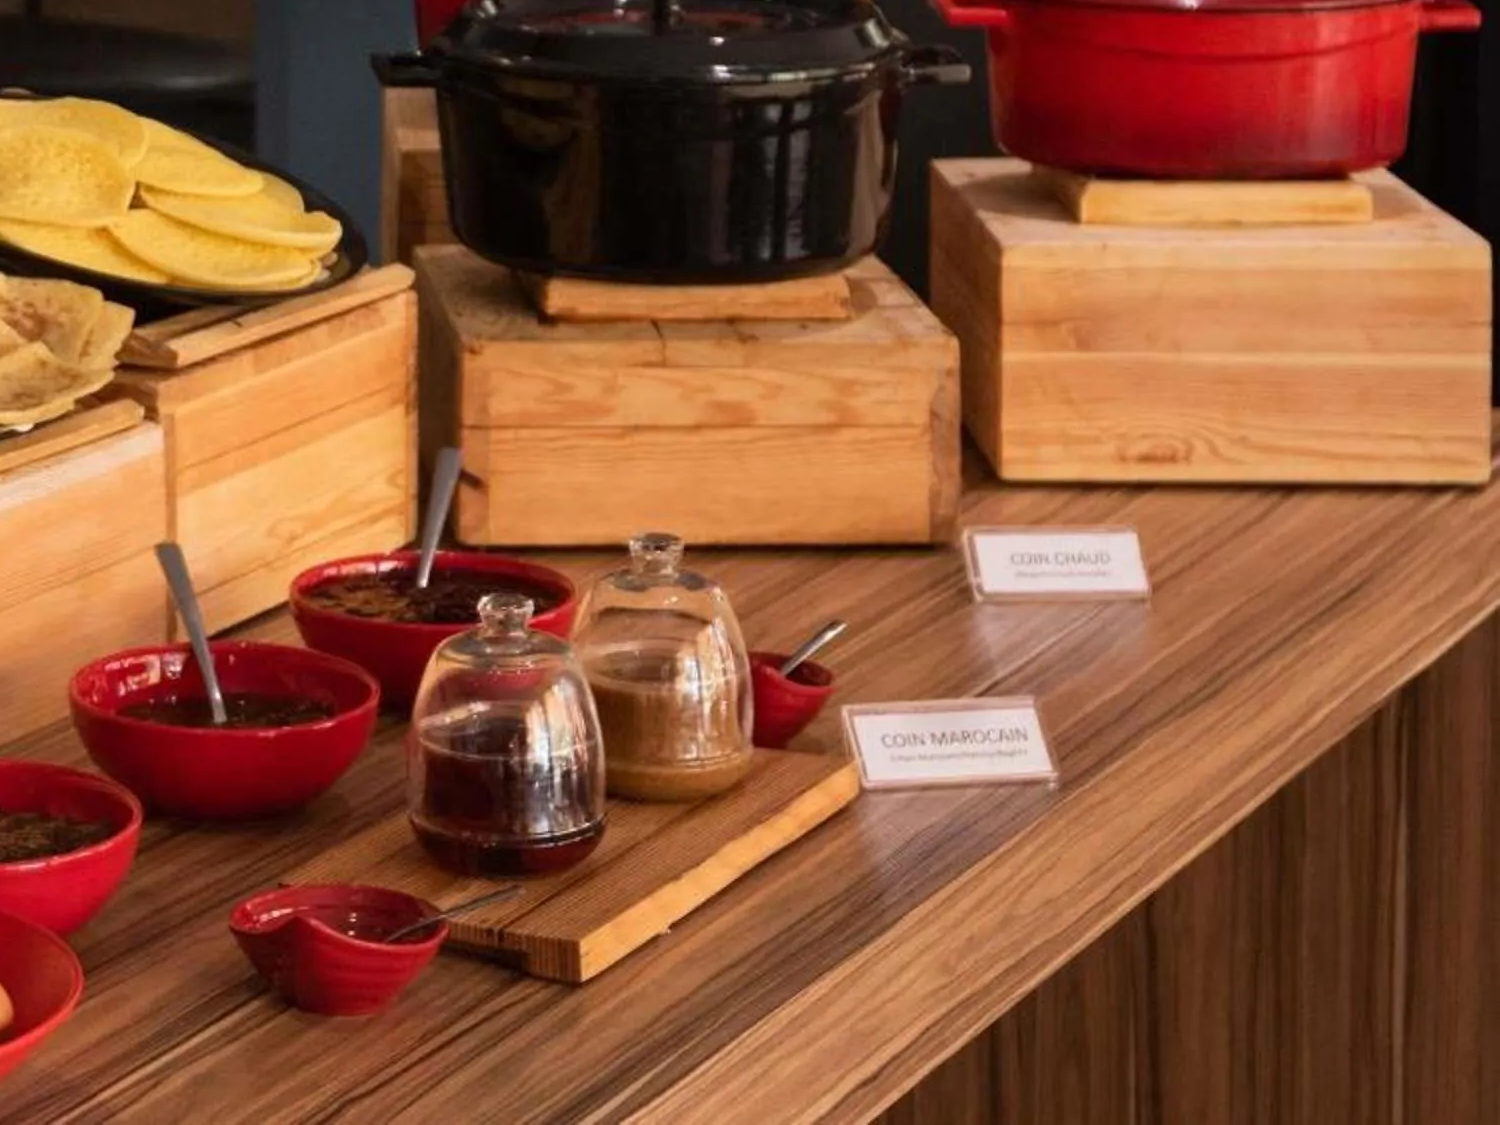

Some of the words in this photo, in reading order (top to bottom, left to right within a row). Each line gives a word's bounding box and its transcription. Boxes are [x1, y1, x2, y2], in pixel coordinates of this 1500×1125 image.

[1010, 553, 1051, 566] COIN
[881, 732, 926, 749] COIN
[931, 728, 1029, 747] MAROCAIN
